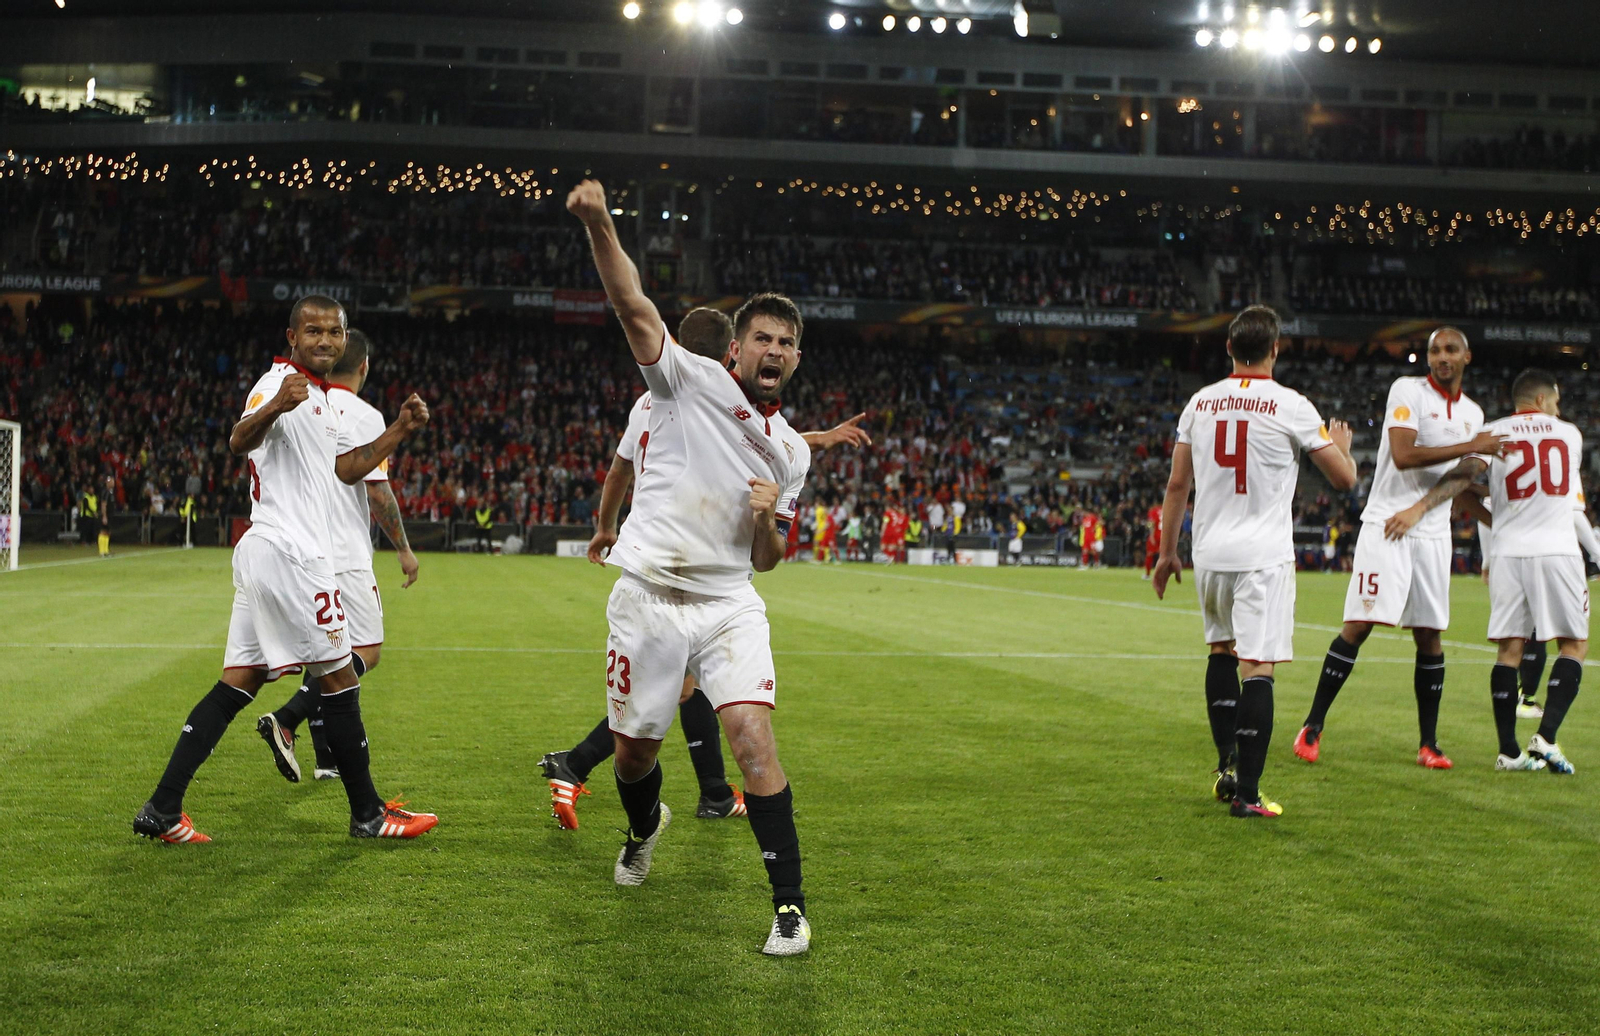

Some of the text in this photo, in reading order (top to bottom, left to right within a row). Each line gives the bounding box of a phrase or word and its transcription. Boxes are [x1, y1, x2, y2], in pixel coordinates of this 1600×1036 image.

[648, 235, 673, 251] A2
[46, 276, 101, 291] LEAGUE
[996, 311, 1138, 327] UEFA EUROPA LEAGUE
[1484, 327, 1524, 341] BASEL
[1214, 420, 1249, 494] 4
[1504, 438, 1570, 501] 20
[1358, 572, 1379, 596] 15
[607, 649, 631, 695] 23
